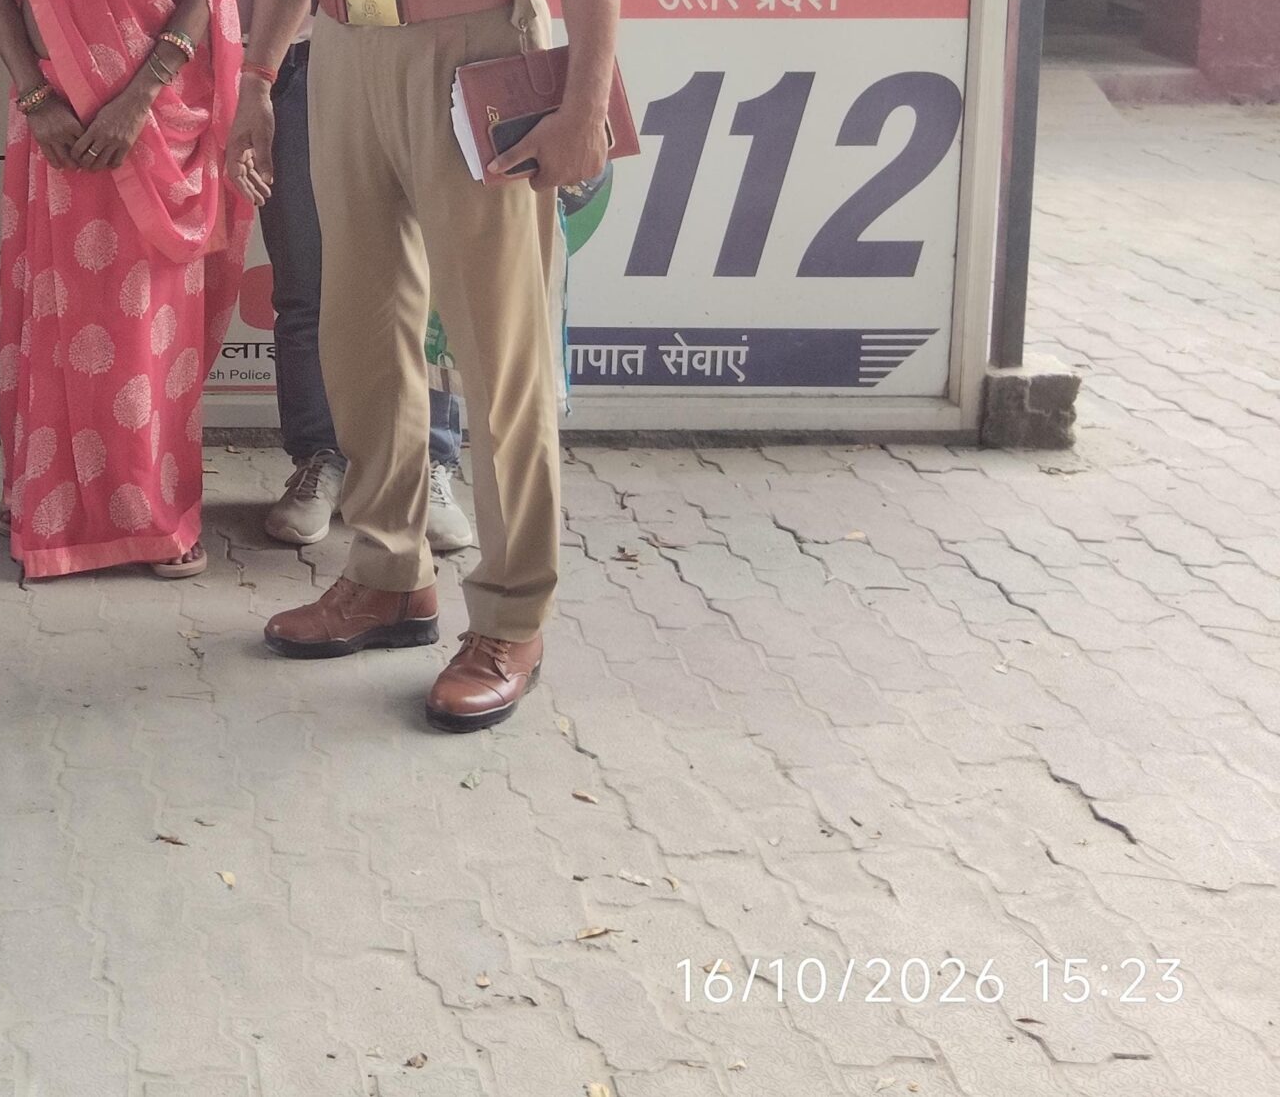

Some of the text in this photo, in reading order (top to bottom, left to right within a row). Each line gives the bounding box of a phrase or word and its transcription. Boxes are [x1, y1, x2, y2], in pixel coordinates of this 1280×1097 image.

[624, 71, 963, 277] 112
[230, 369, 271, 380] Police
[659, 332, 750, 381] सेवाएं
